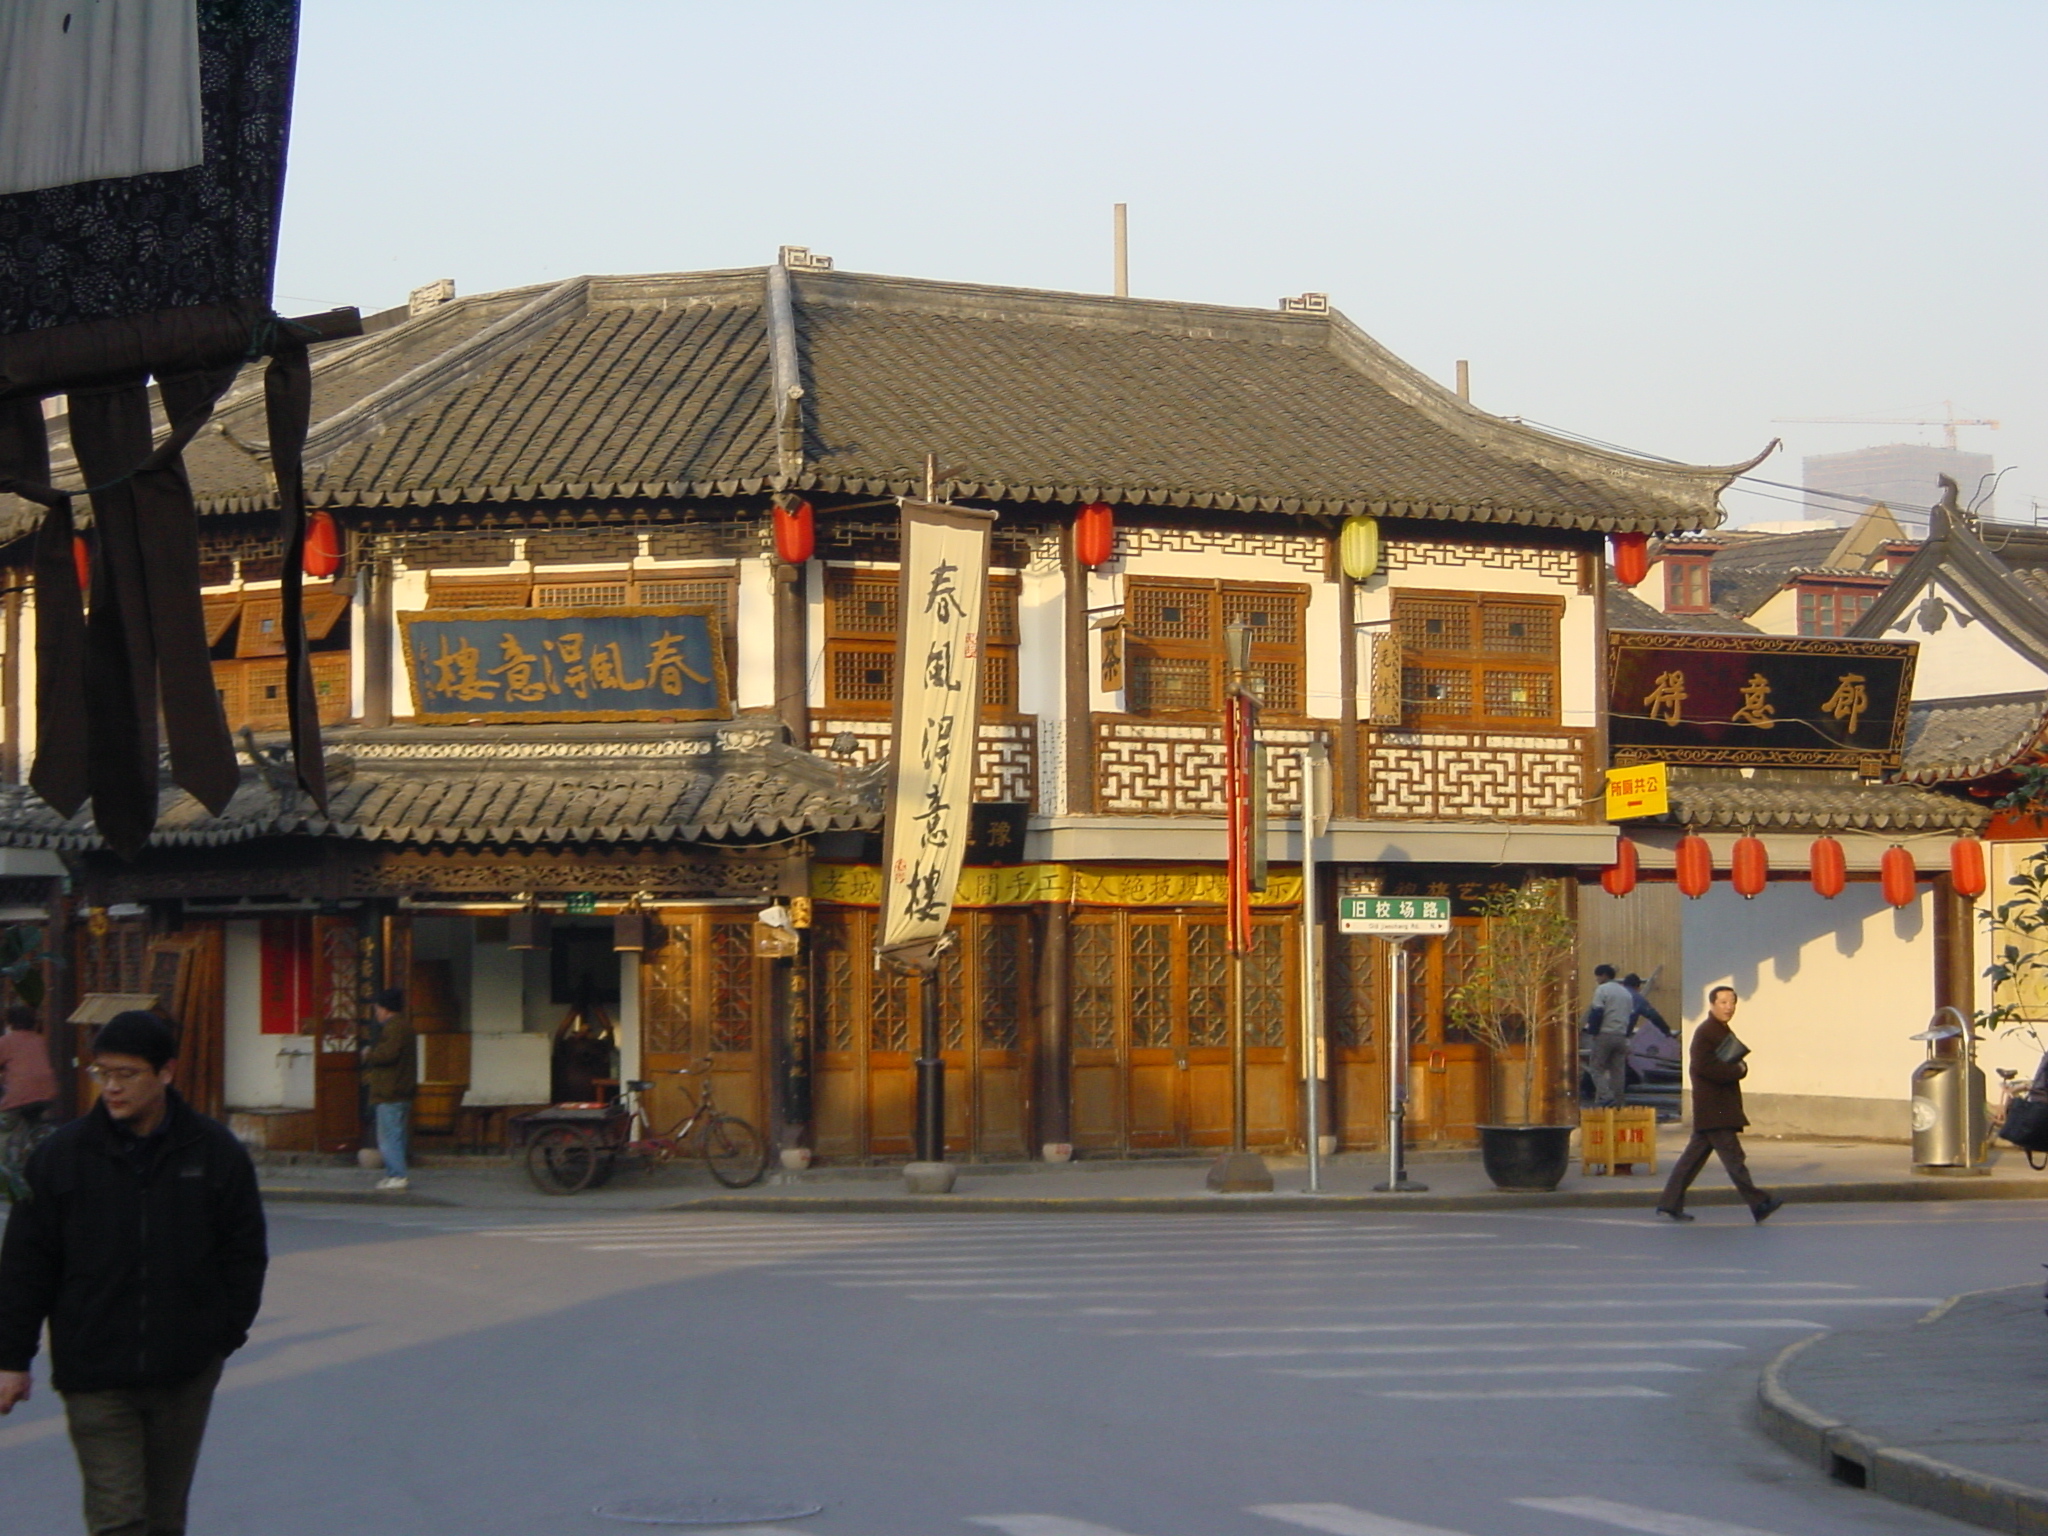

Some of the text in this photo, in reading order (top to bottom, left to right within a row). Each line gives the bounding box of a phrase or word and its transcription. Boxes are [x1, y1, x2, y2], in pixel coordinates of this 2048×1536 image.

[1102, 632, 1121, 682] 茶
[1352, 901, 1438, 918] 旧校场路
